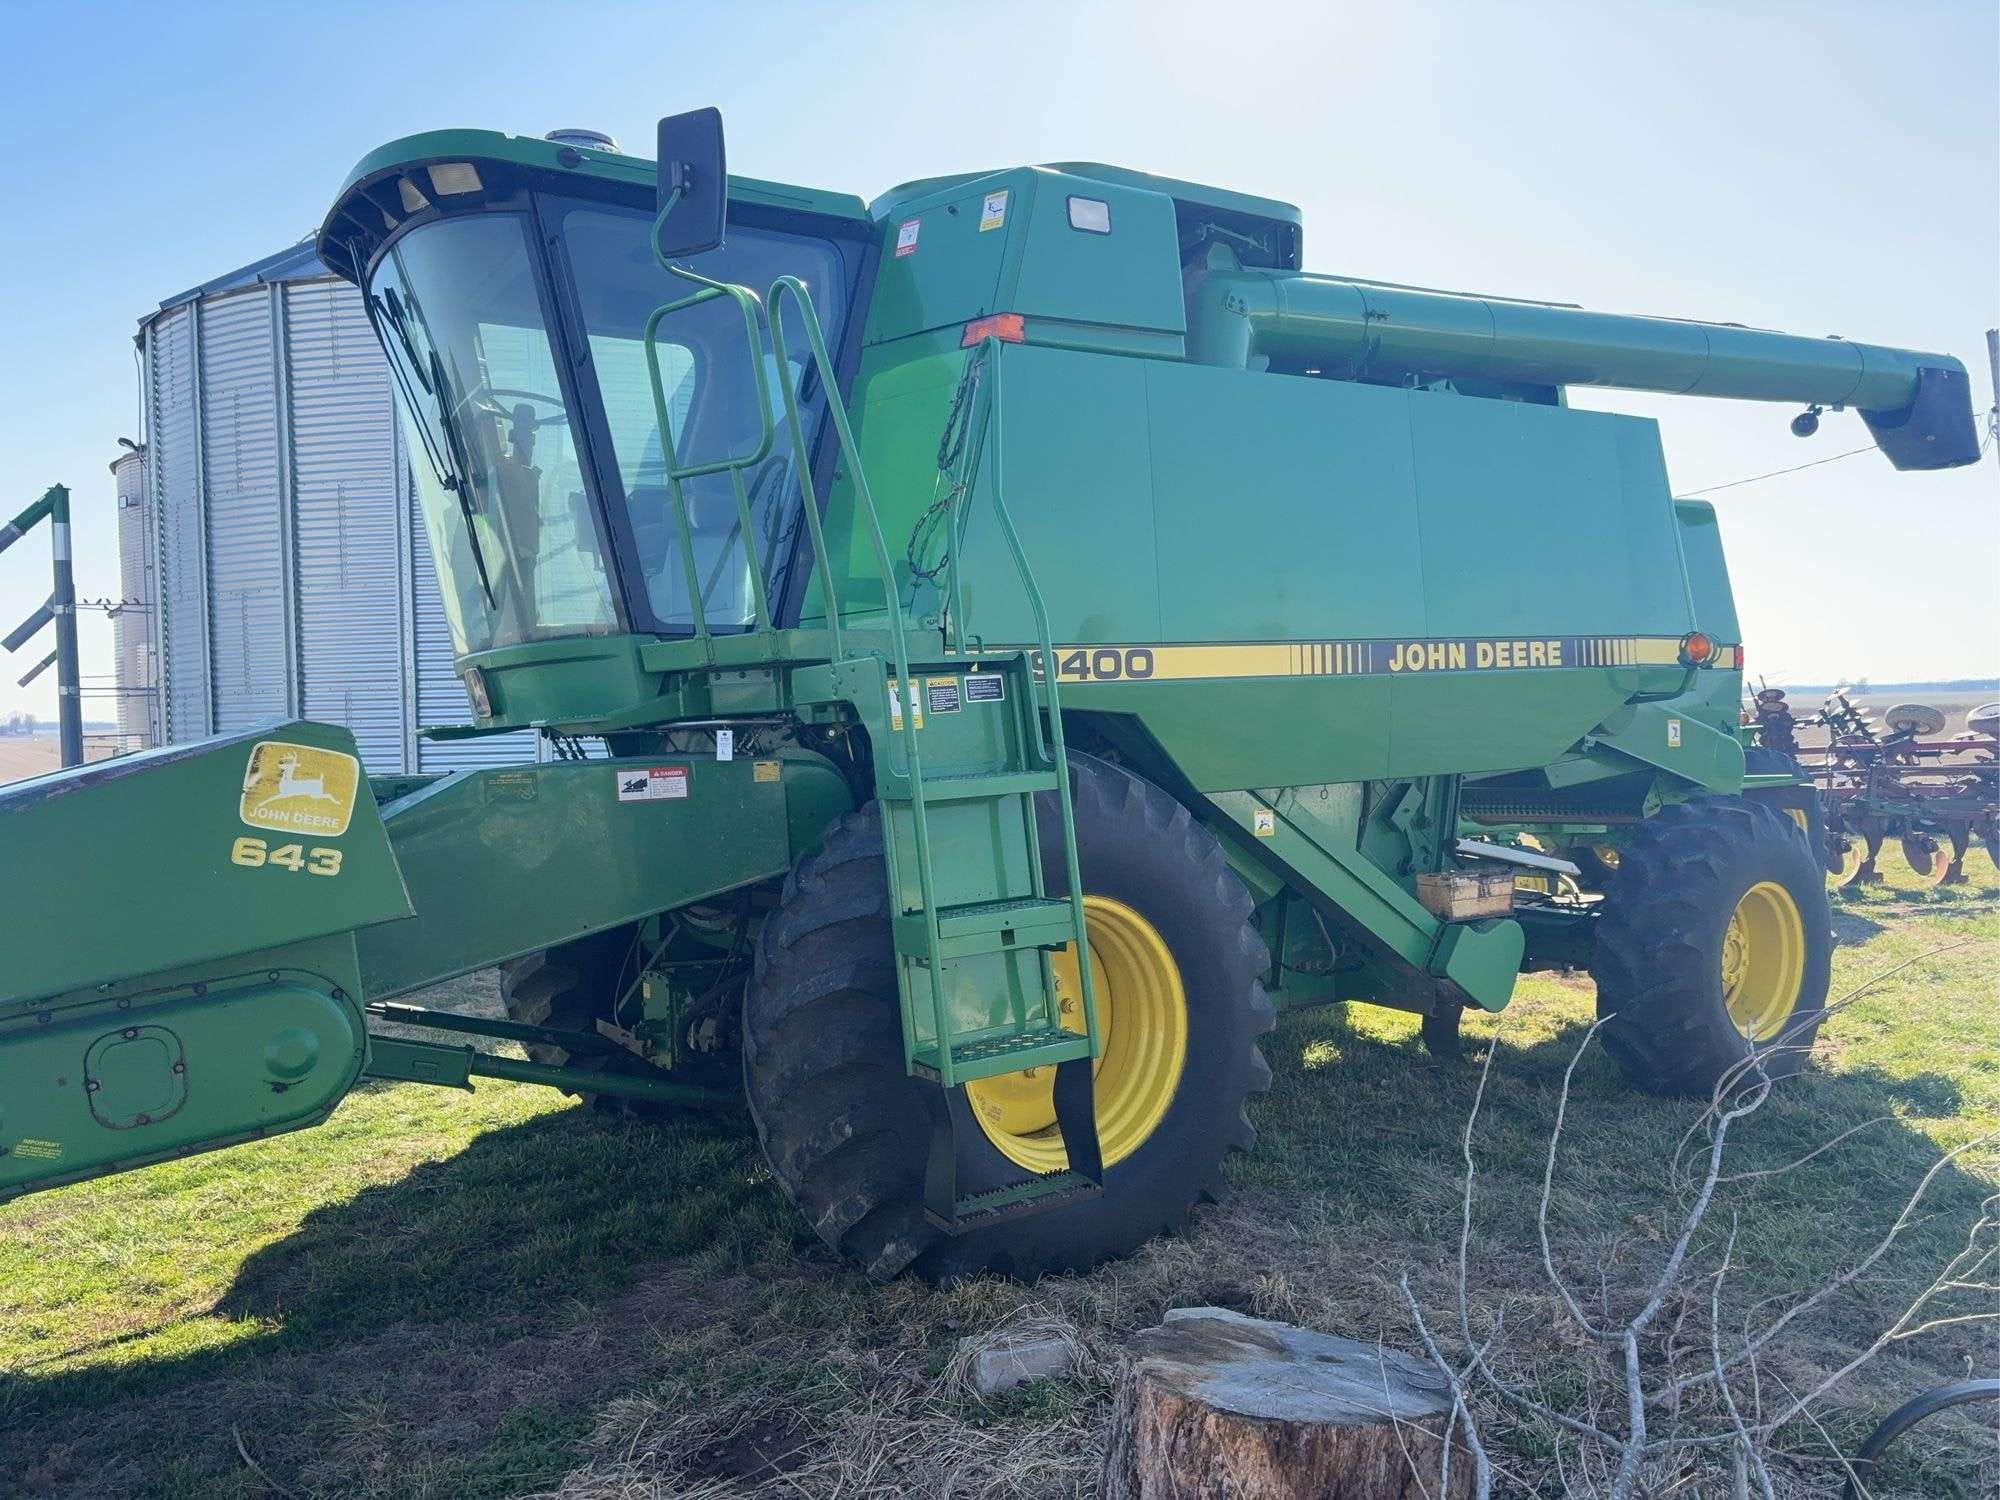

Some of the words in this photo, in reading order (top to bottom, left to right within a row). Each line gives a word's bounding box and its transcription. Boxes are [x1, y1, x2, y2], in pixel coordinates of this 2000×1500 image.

[1030, 649, 1154, 681] 9400
[1389, 642, 1467, 672] JOHN
[1476, 640, 1563, 668] DEERE
[660, 769, 683, 777] DANGER
[249, 806, 290, 821] JOHN
[293, 812, 341, 828] DEERE
[230, 836, 343, 877] 643
[22, 1137, 61, 1149] IMPORTANT
